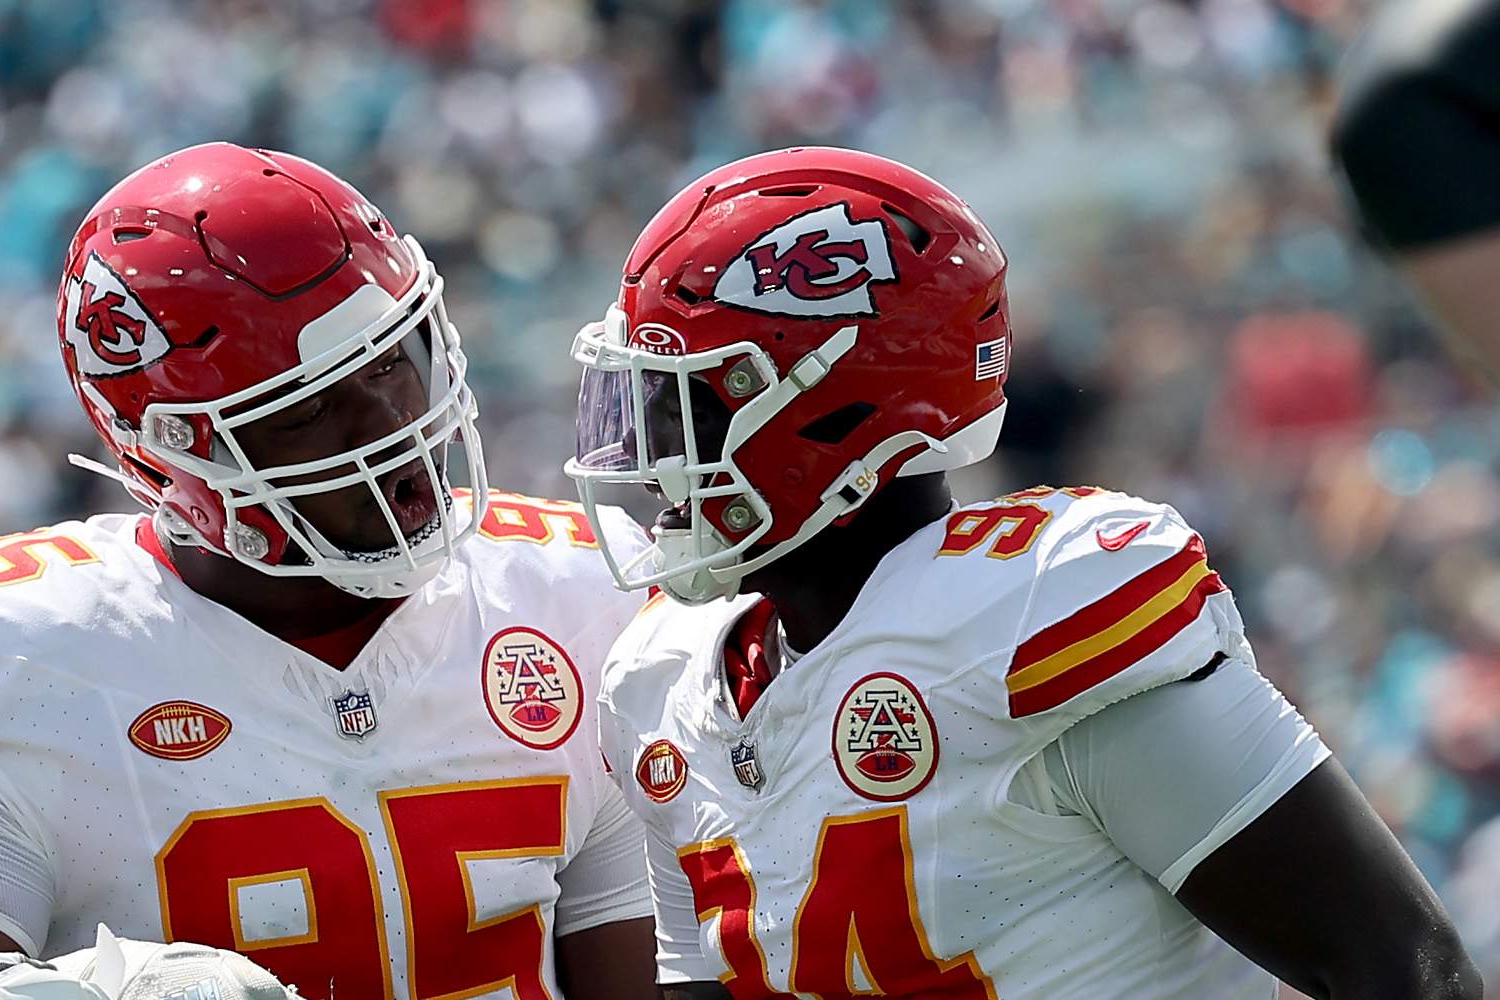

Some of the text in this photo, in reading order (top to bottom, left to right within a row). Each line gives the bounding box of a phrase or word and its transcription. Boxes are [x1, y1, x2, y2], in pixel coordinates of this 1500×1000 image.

[744, 228, 871, 299] KC
[75, 280, 147, 367] KC
[630, 342, 681, 357] OAKLEY
[855, 467, 878, 492] 94
[153, 715, 207, 746] NKH
[341, 709, 374, 734] NFL
[649, 755, 677, 786] NKH
[734, 763, 761, 784] NFL
